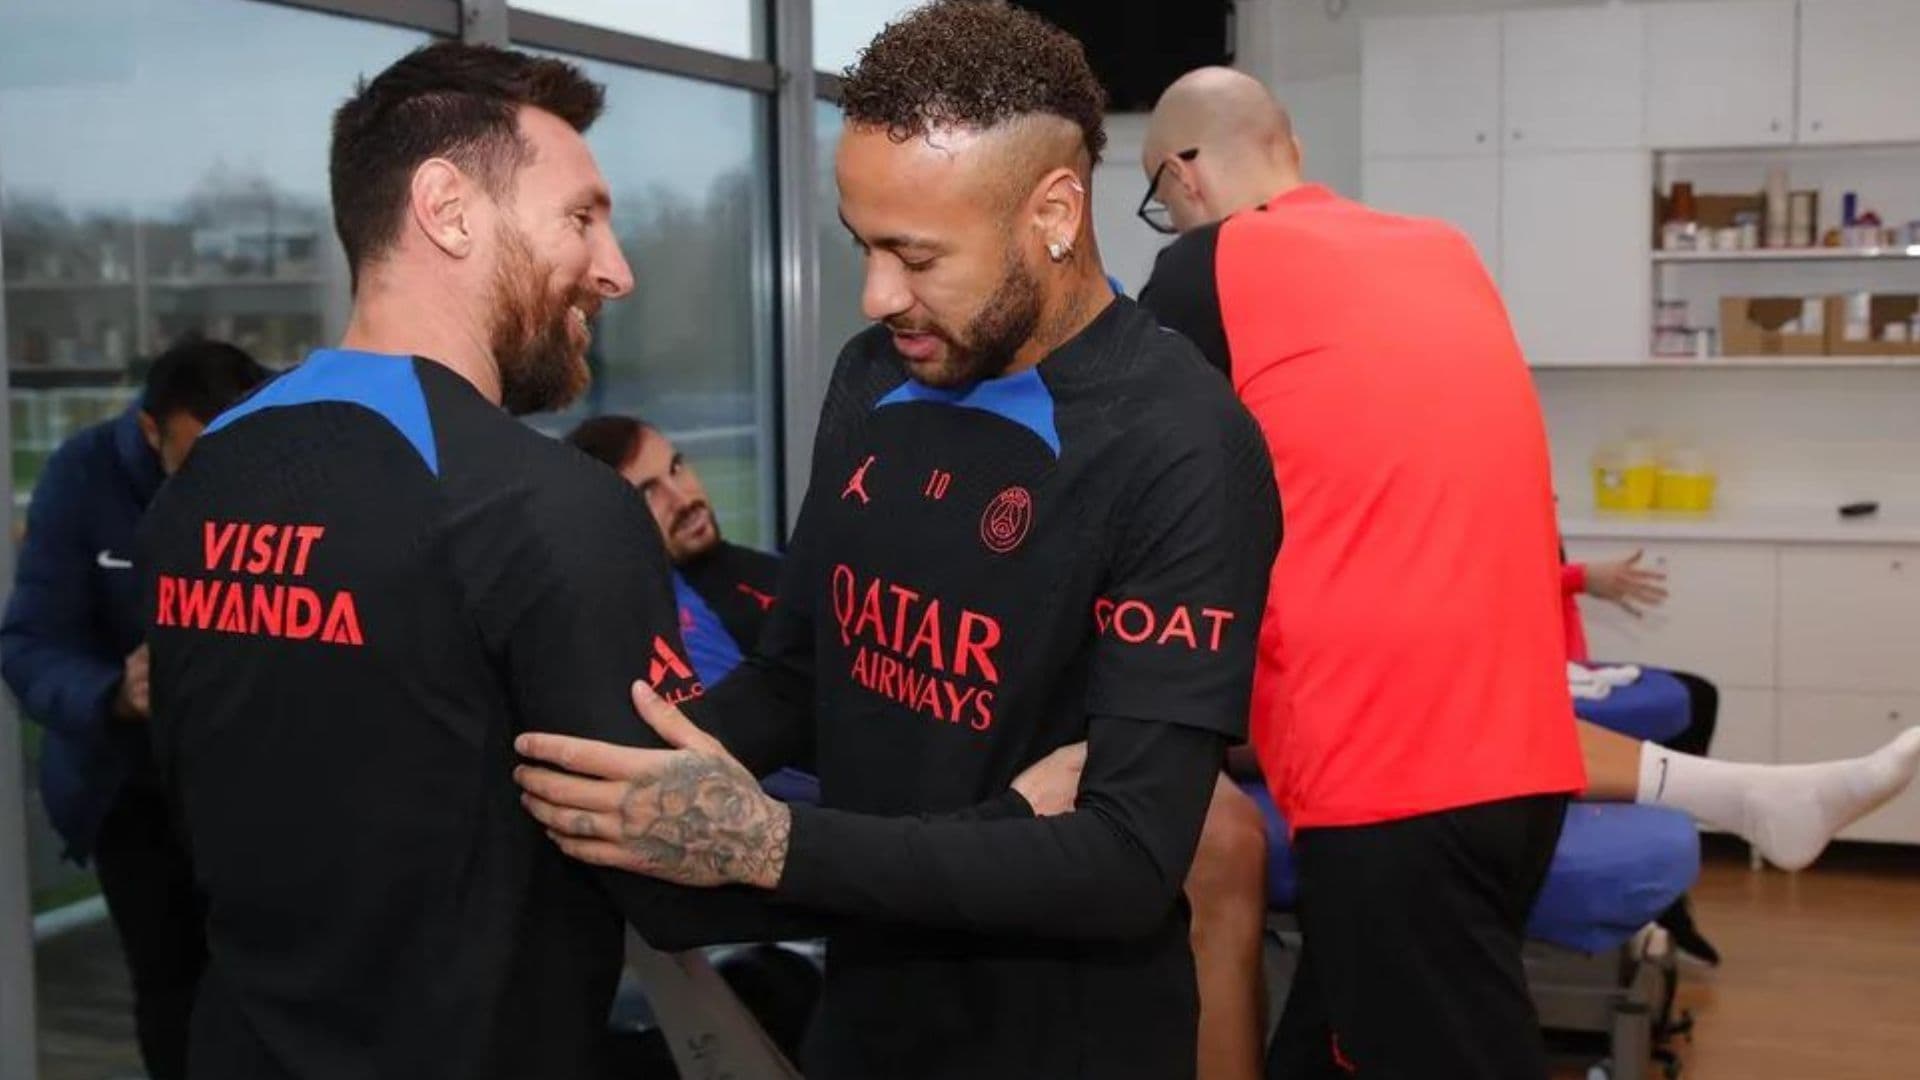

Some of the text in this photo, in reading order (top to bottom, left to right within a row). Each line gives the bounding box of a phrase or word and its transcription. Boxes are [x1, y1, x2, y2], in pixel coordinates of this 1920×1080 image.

[926, 470, 952, 499] 10
[204, 522, 325, 575] VISIT
[156, 575, 366, 646] RWANDA
[832, 564, 1001, 684] QATAR
[851, 646, 995, 730] AIRWAYS
